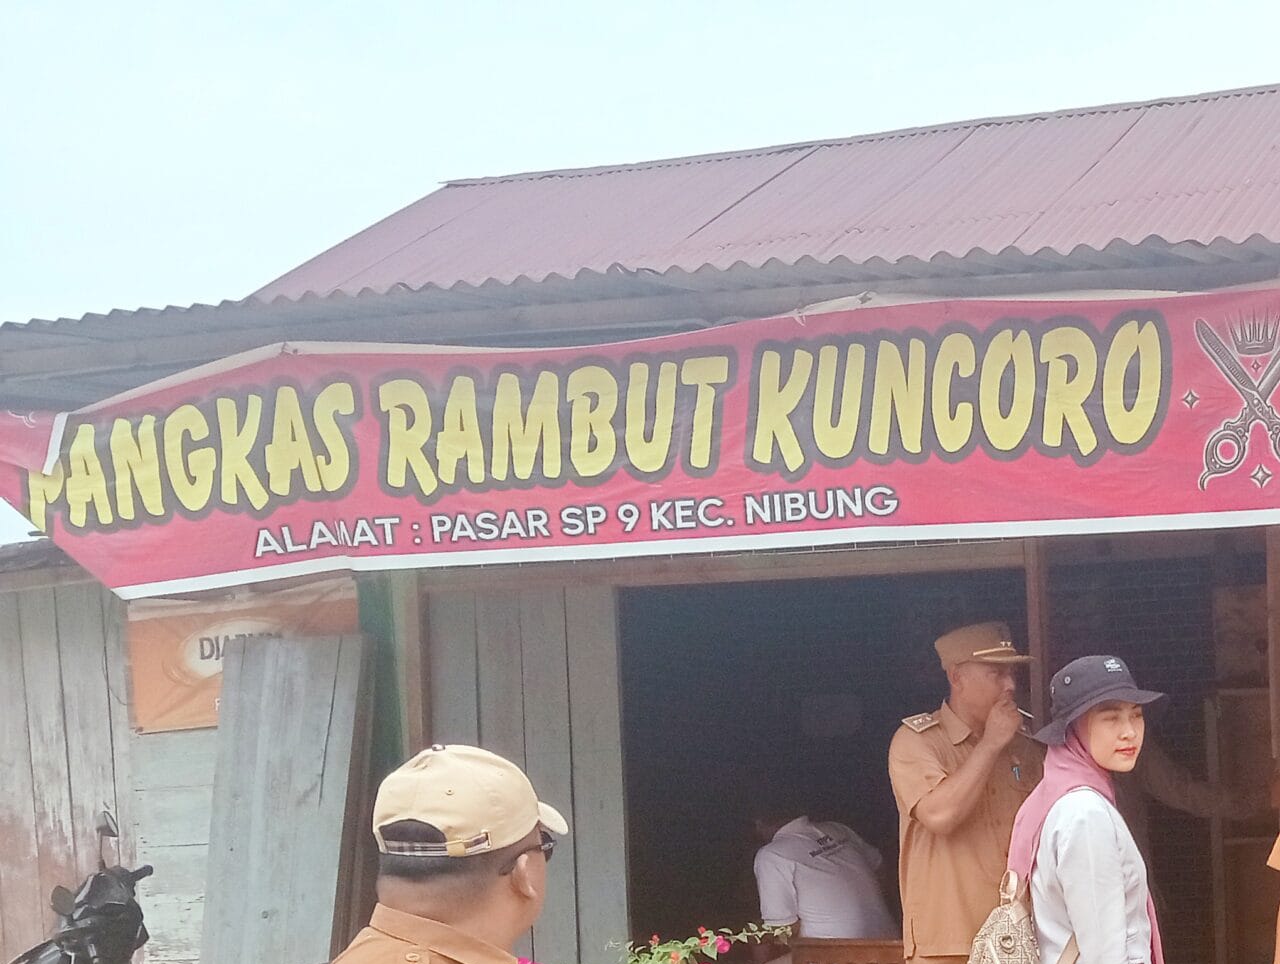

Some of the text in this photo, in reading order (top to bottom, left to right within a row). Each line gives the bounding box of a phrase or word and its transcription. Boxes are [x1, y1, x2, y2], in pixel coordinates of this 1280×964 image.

[379, 356, 729, 496] RAMBUT
[752, 320, 1161, 472] KUNCORO
[431, 509, 550, 543] PASAR
[560, 506, 607, 536] SP
[618, 503, 640, 532] 9
[650, 497, 735, 530] KEC.
[745, 486, 898, 524] NIBUNG
